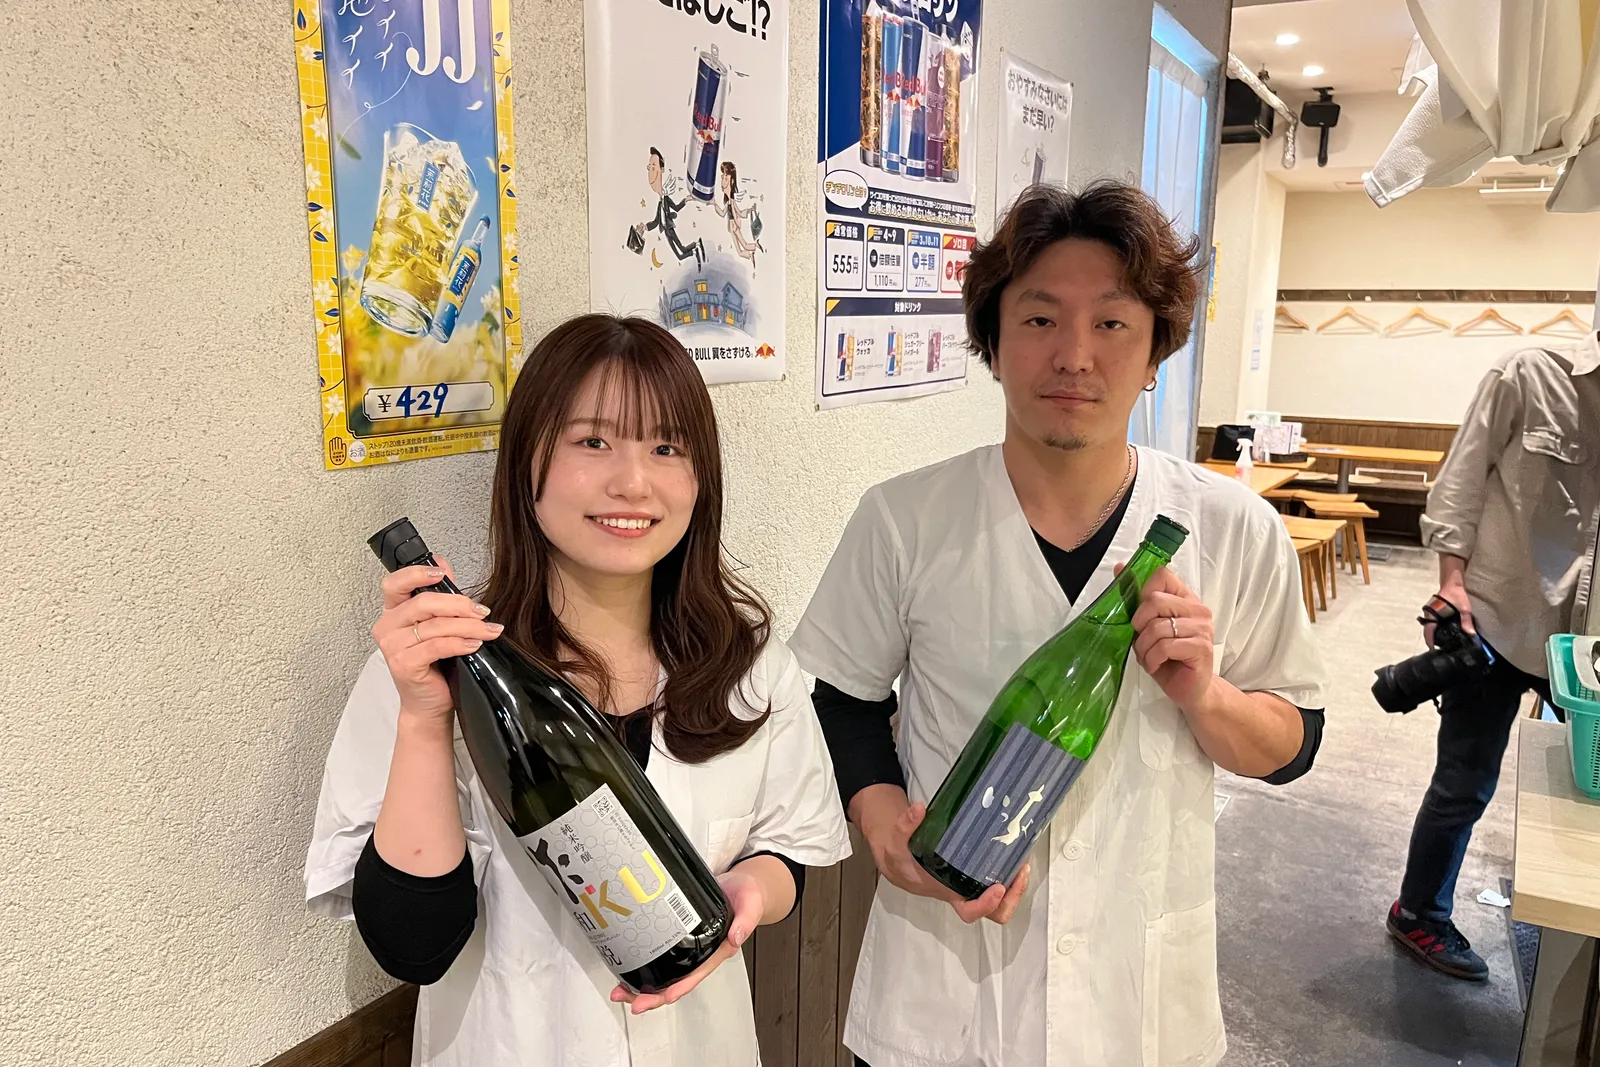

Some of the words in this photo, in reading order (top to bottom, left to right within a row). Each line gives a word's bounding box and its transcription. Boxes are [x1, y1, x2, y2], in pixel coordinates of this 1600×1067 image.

[373, 0, 397, 72] イイ
[1007, 70, 1068, 115] おやすみなさいには
[1022, 104, 1055, 133] まだ早い?
[833, 223, 859, 239] 通常価格
[894, 302, 922, 313] 対象ドリンク
[695, 348, 711, 360] BULL
[396, 382, 449, 418] 429
[560, 823, 594, 865] 純米吟醸
